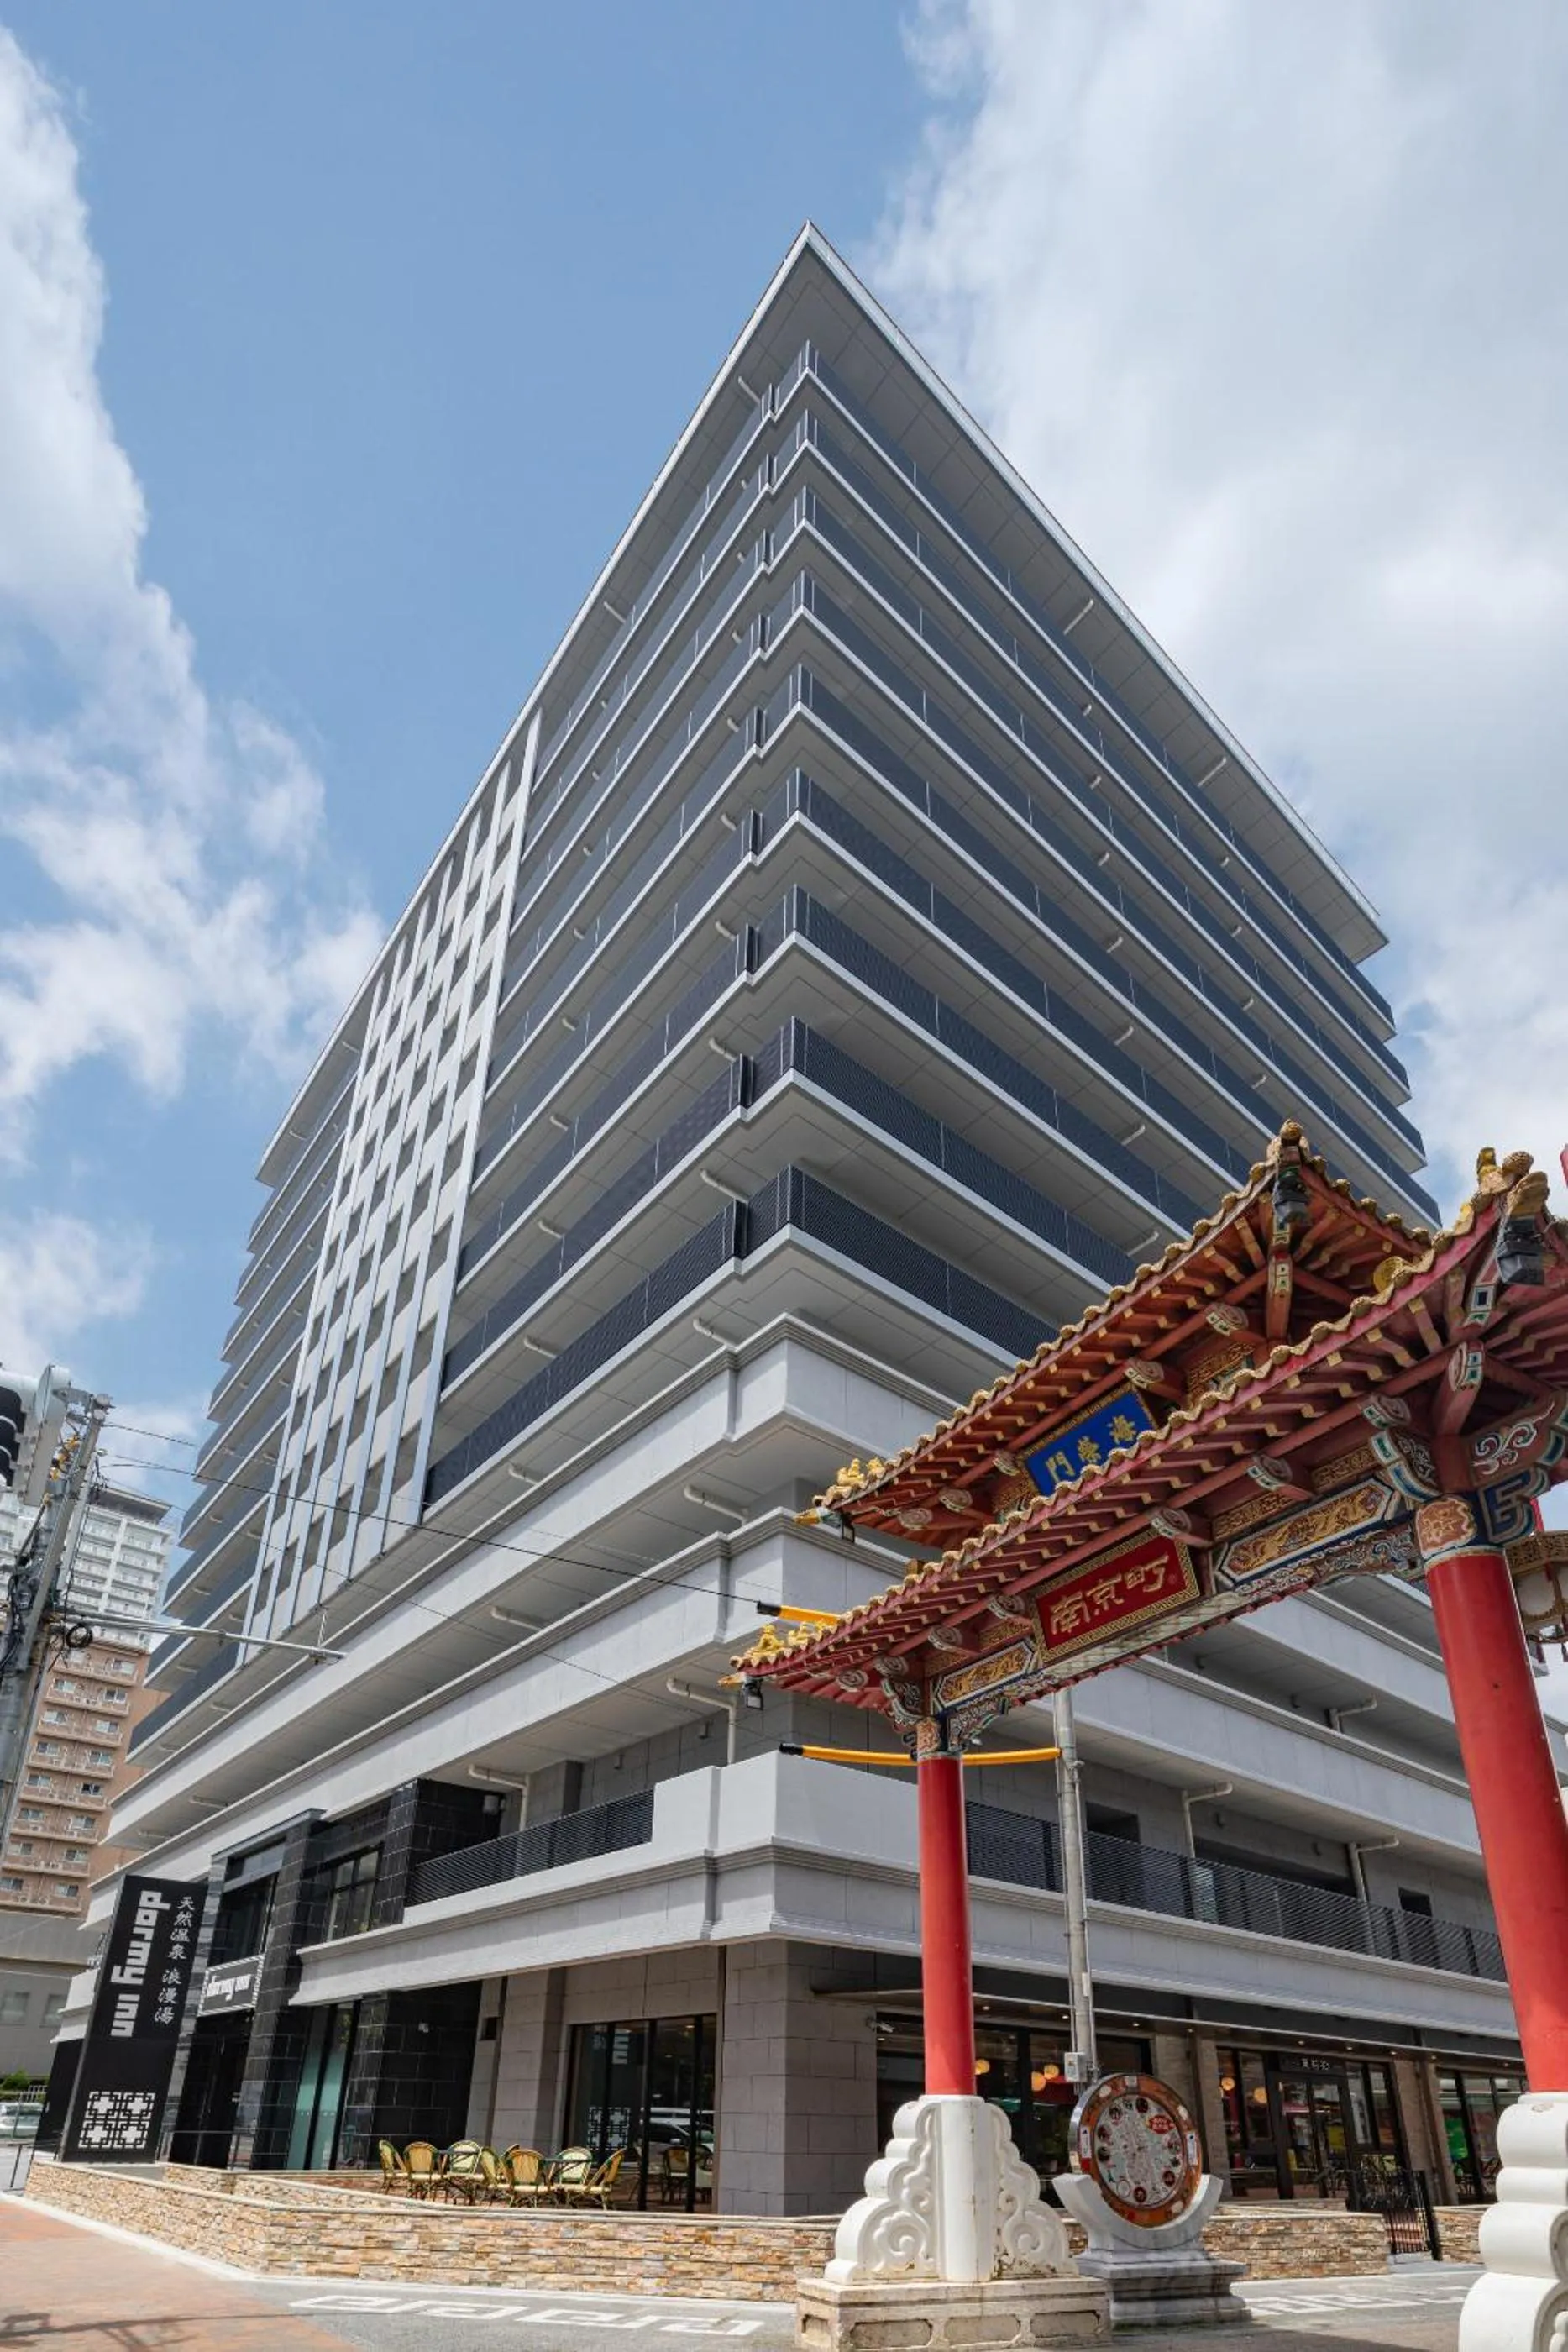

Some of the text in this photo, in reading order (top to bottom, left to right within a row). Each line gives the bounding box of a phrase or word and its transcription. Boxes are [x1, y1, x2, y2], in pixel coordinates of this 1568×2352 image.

[1050, 1552, 1169, 1635] 南京町
[110, 1890, 171, 2038] dormy inn
[168, 1896, 196, 1961] 天然温泉
